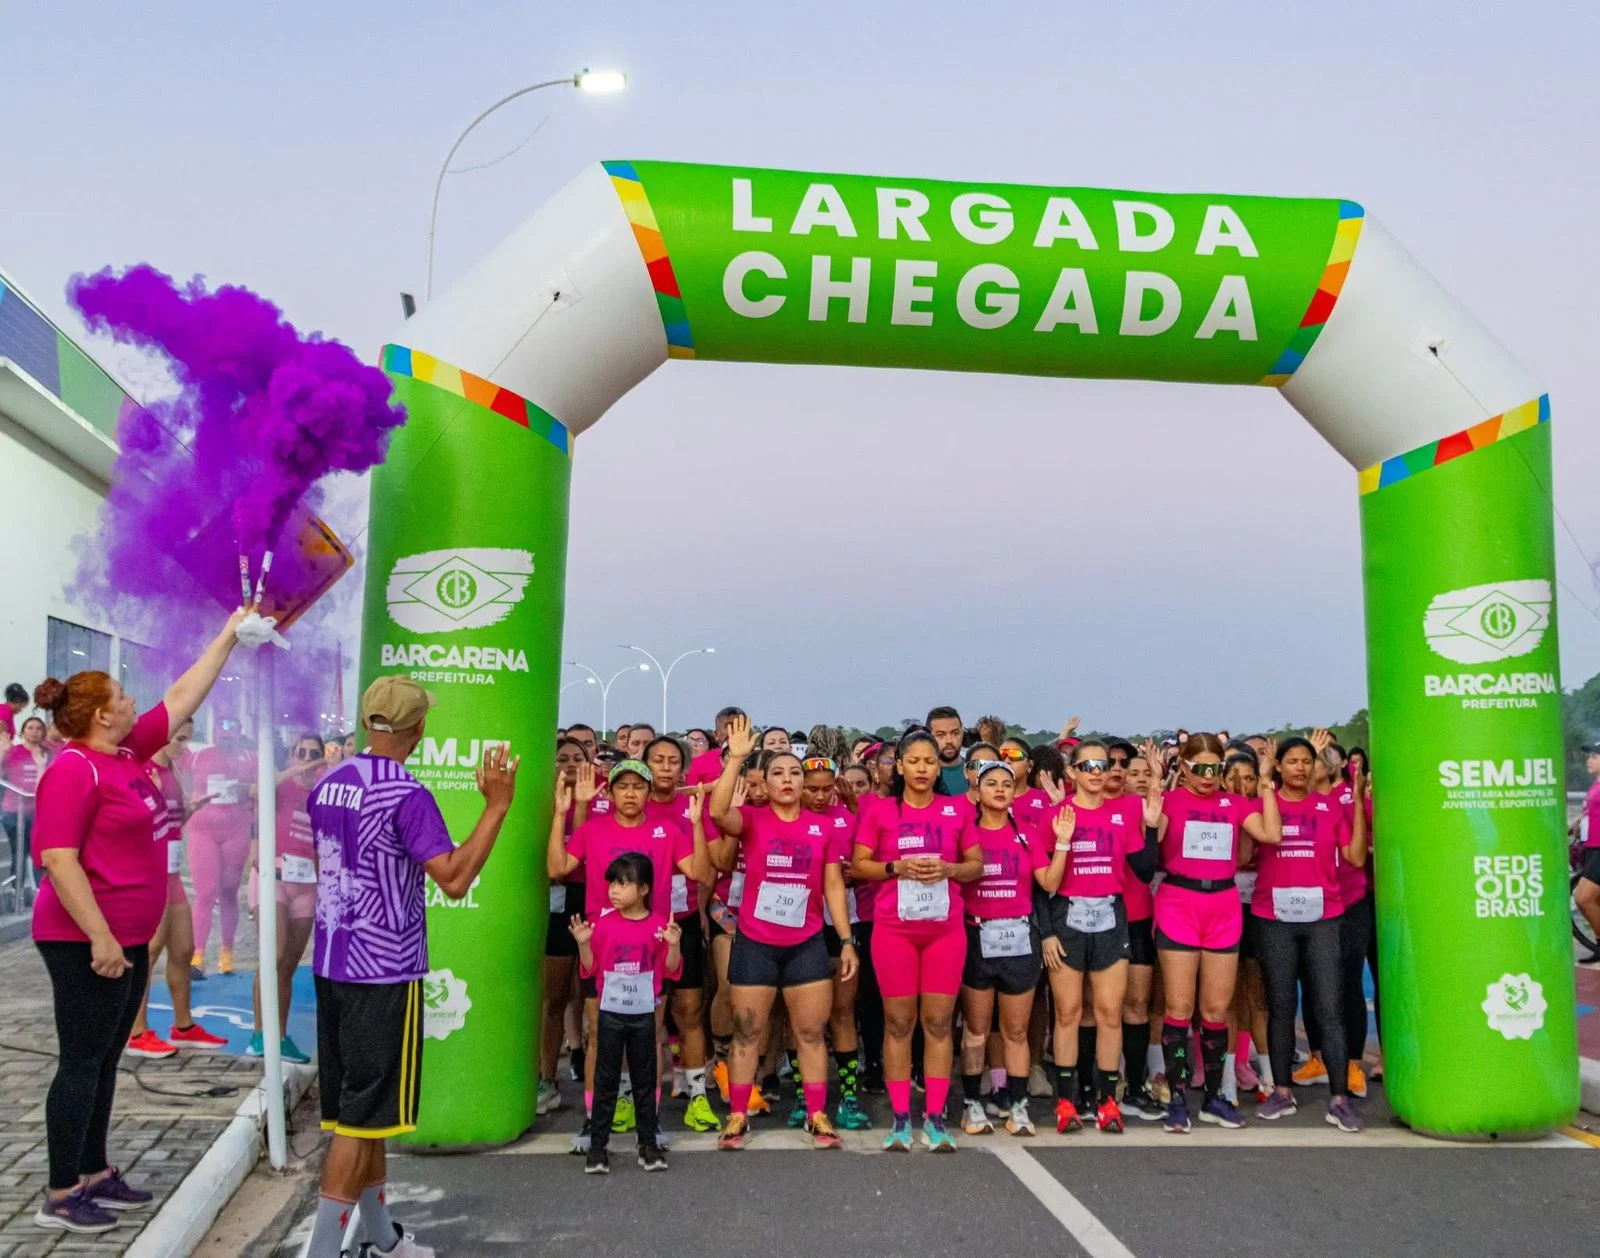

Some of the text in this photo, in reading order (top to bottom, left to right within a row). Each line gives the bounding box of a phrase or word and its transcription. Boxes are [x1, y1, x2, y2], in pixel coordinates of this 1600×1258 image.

[732, 178, 1260, 258] LARGADA
[722, 251, 1259, 341] CHEGADA
[381, 644, 530, 673] BARCARENA
[410, 671, 495, 685] PREFEITURA
[1424, 672, 1557, 697] BARCARENA
[1461, 698, 1538, 709] PREFEITURA
[1438, 758, 1557, 788] SEMJEL
[316, 782, 364, 811] ATLTA
[1201, 831, 1218, 840] 054
[1473, 854, 1543, 875] REDE
[1475, 872, 1544, 900] ODS
[776, 894, 794, 906] 230
[916, 892, 933, 902] 103
[1475, 898, 1544, 918] BRASIL
[999, 931, 1015, 940] 244
